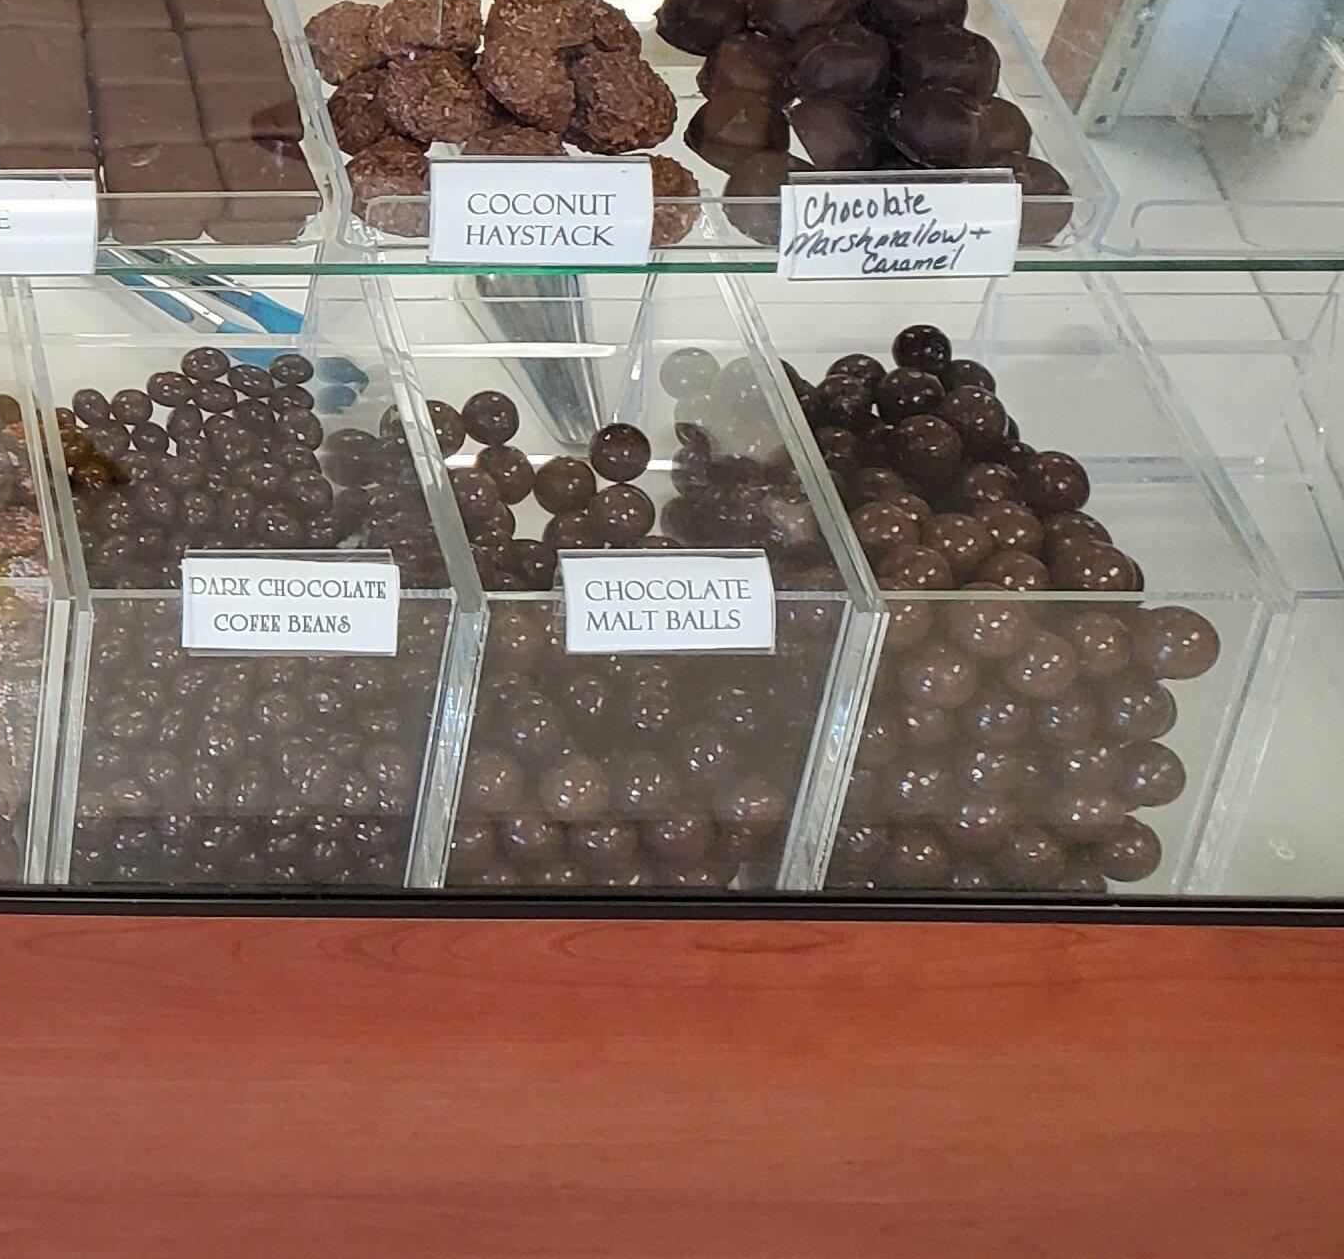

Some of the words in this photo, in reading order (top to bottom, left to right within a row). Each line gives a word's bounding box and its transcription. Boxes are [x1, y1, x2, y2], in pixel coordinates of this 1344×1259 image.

[466, 192, 617, 217] COCONUT
[465, 224, 615, 248] HAYSTACK
[189, 576, 249, 597] DARK
[258, 578, 387, 600] CHOCOLATE
[585, 578, 751, 601] CHOCOLATE
[213, 613, 281, 633] COFEE
[287, 614, 351, 634] BEANS
[585, 609, 655, 631] MALT
[666, 608, 741, 631] BALLS
